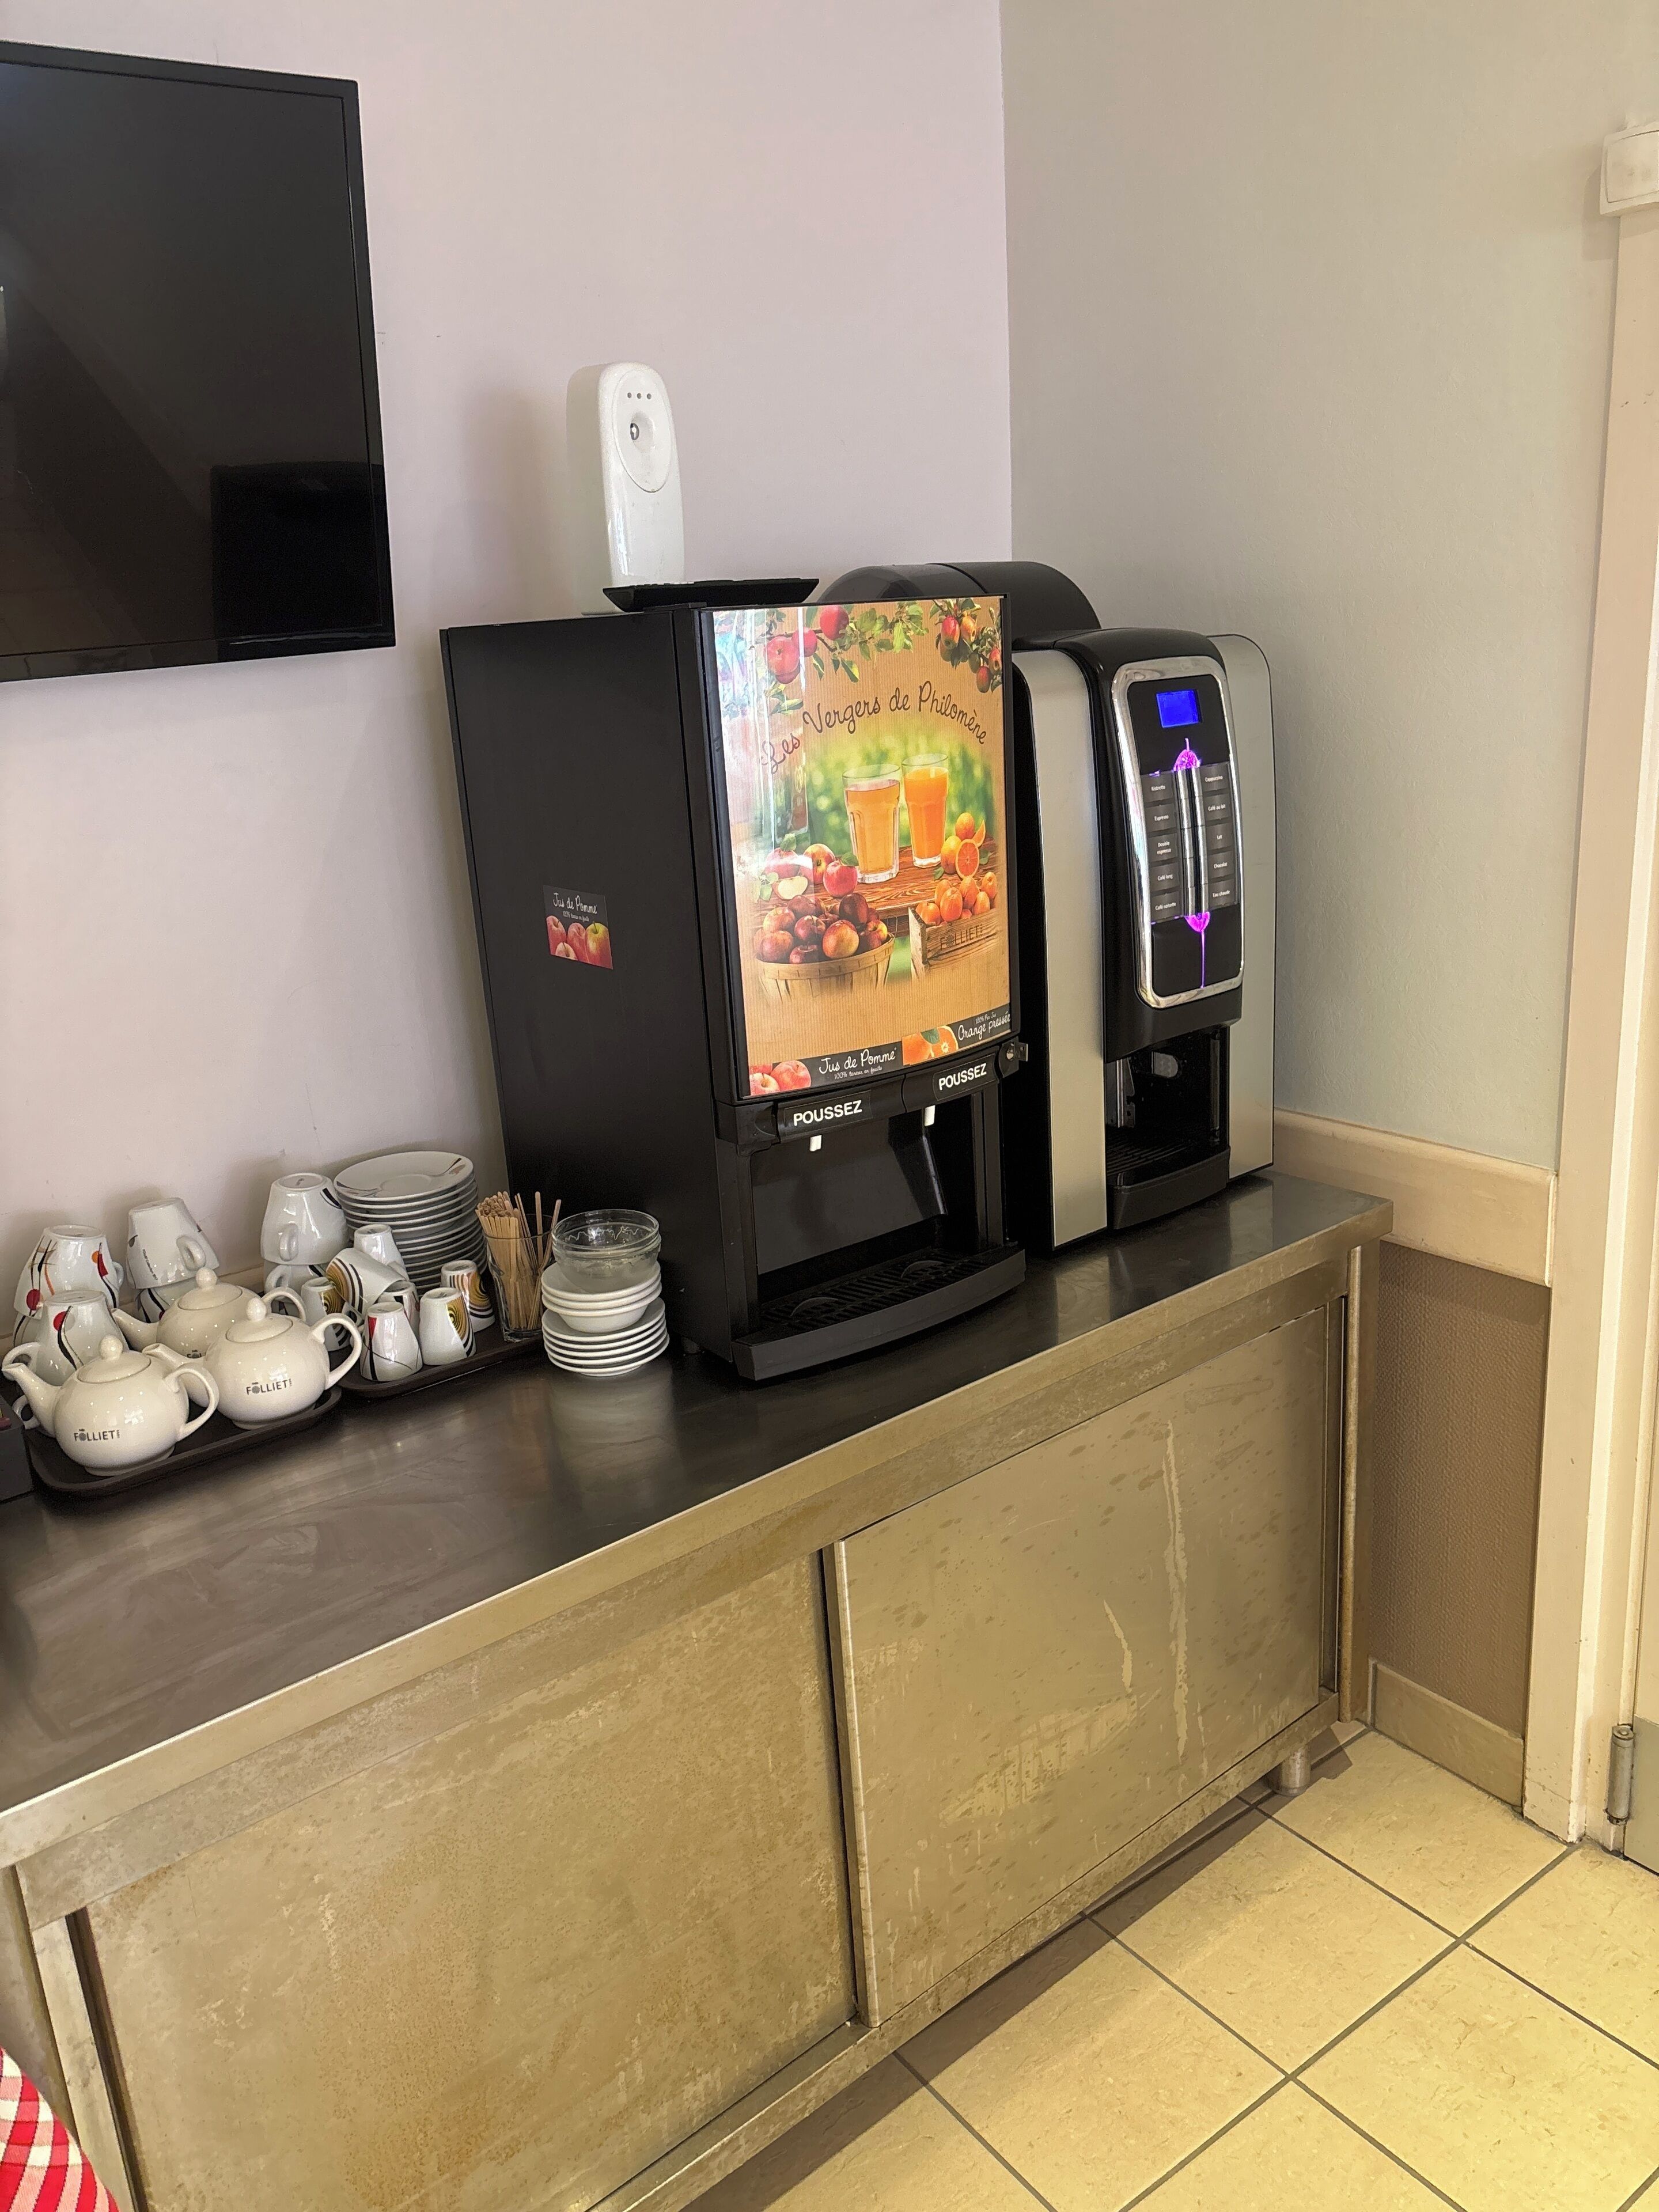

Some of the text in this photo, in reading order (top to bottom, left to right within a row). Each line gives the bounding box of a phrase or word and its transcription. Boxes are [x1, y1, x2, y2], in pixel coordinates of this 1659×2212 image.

[802, 696, 881, 734] Vergers
[889, 687, 911, 712] de
[918, 680, 987, 745] Philomène
[553, 892, 565, 908] Jus
[566, 897, 574, 910] de
[958, 1010, 1010, 1040] Orange pressée
[819, 1058, 840, 1074] Jus
[844, 1056, 858, 1070] de
[834, 1071, 847, 1080] 100%
[938, 1063, 987, 1090] POUSSEZ
[793, 1099, 863, 1126] POUSSEZ
